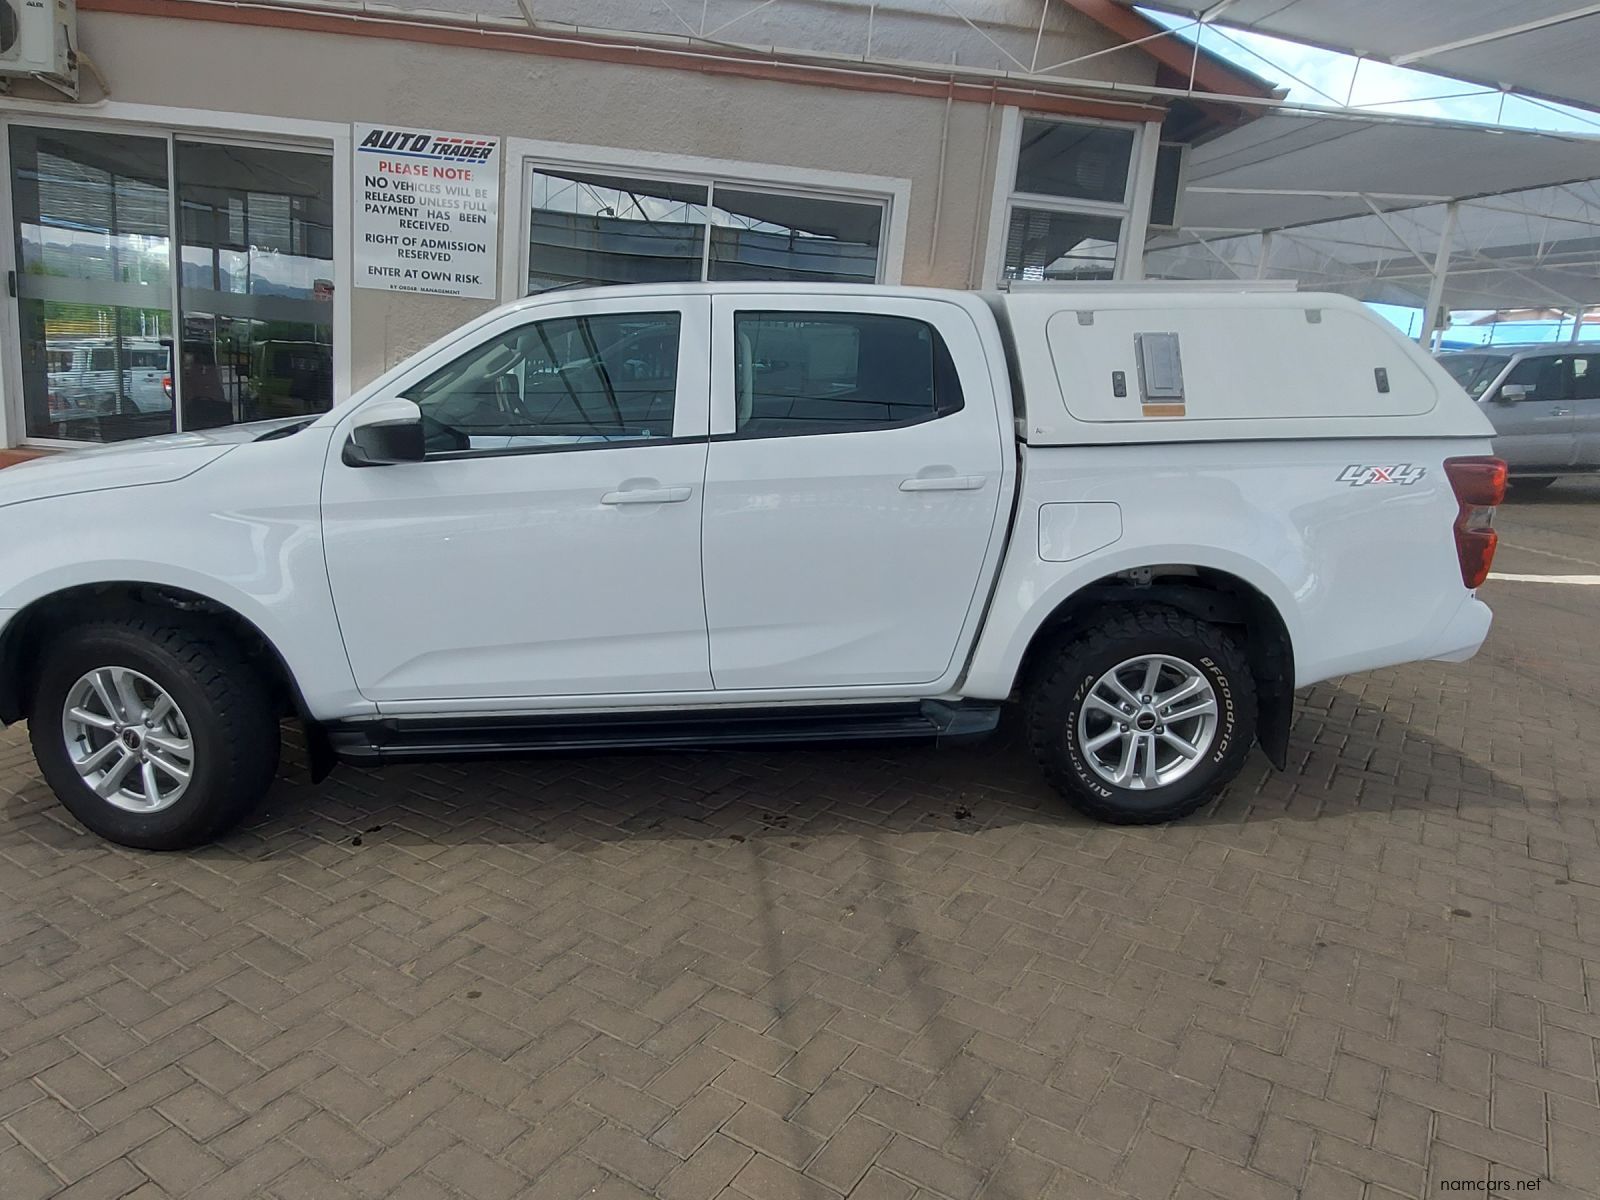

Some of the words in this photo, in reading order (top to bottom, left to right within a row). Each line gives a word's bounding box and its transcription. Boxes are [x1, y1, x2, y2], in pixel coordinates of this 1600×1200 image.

[360, 129, 431, 152] AUTO
[430, 143, 494, 159] TRADER
[379, 161, 428, 176] PLEASE
[365, 175, 388, 189] NO
[392, 180, 441, 194] VEHICLES
[445, 186, 470, 198] WILL
[475, 188, 488, 199] BE
[365, 191, 415, 205] RELEASED
[419, 197, 460, 210] UNLESS
[463, 201, 487, 212] FULL
[365, 203, 419, 218] PAYMENT
[427, 210, 450, 221] HAS
[459, 213, 487, 224] BEEN
[399, 219, 452, 233] RECEIVED.
[365, 233, 399, 245] RIGHT
[402, 236, 418, 247] OF
[420, 238, 486, 253] ADMISSION
[368, 265, 401, 278] ENTER
[404, 269, 418, 279] AT
[421, 270, 451, 282] OWN
[455, 273, 483, 285] RISK.
[420, 287, 461, 295] MANAGEMENT
[1073, 674, 1094, 701] T/A
[1199, 656, 1235, 763] BFGoodrich
[1066, 711, 1112, 798] All-Terrain
